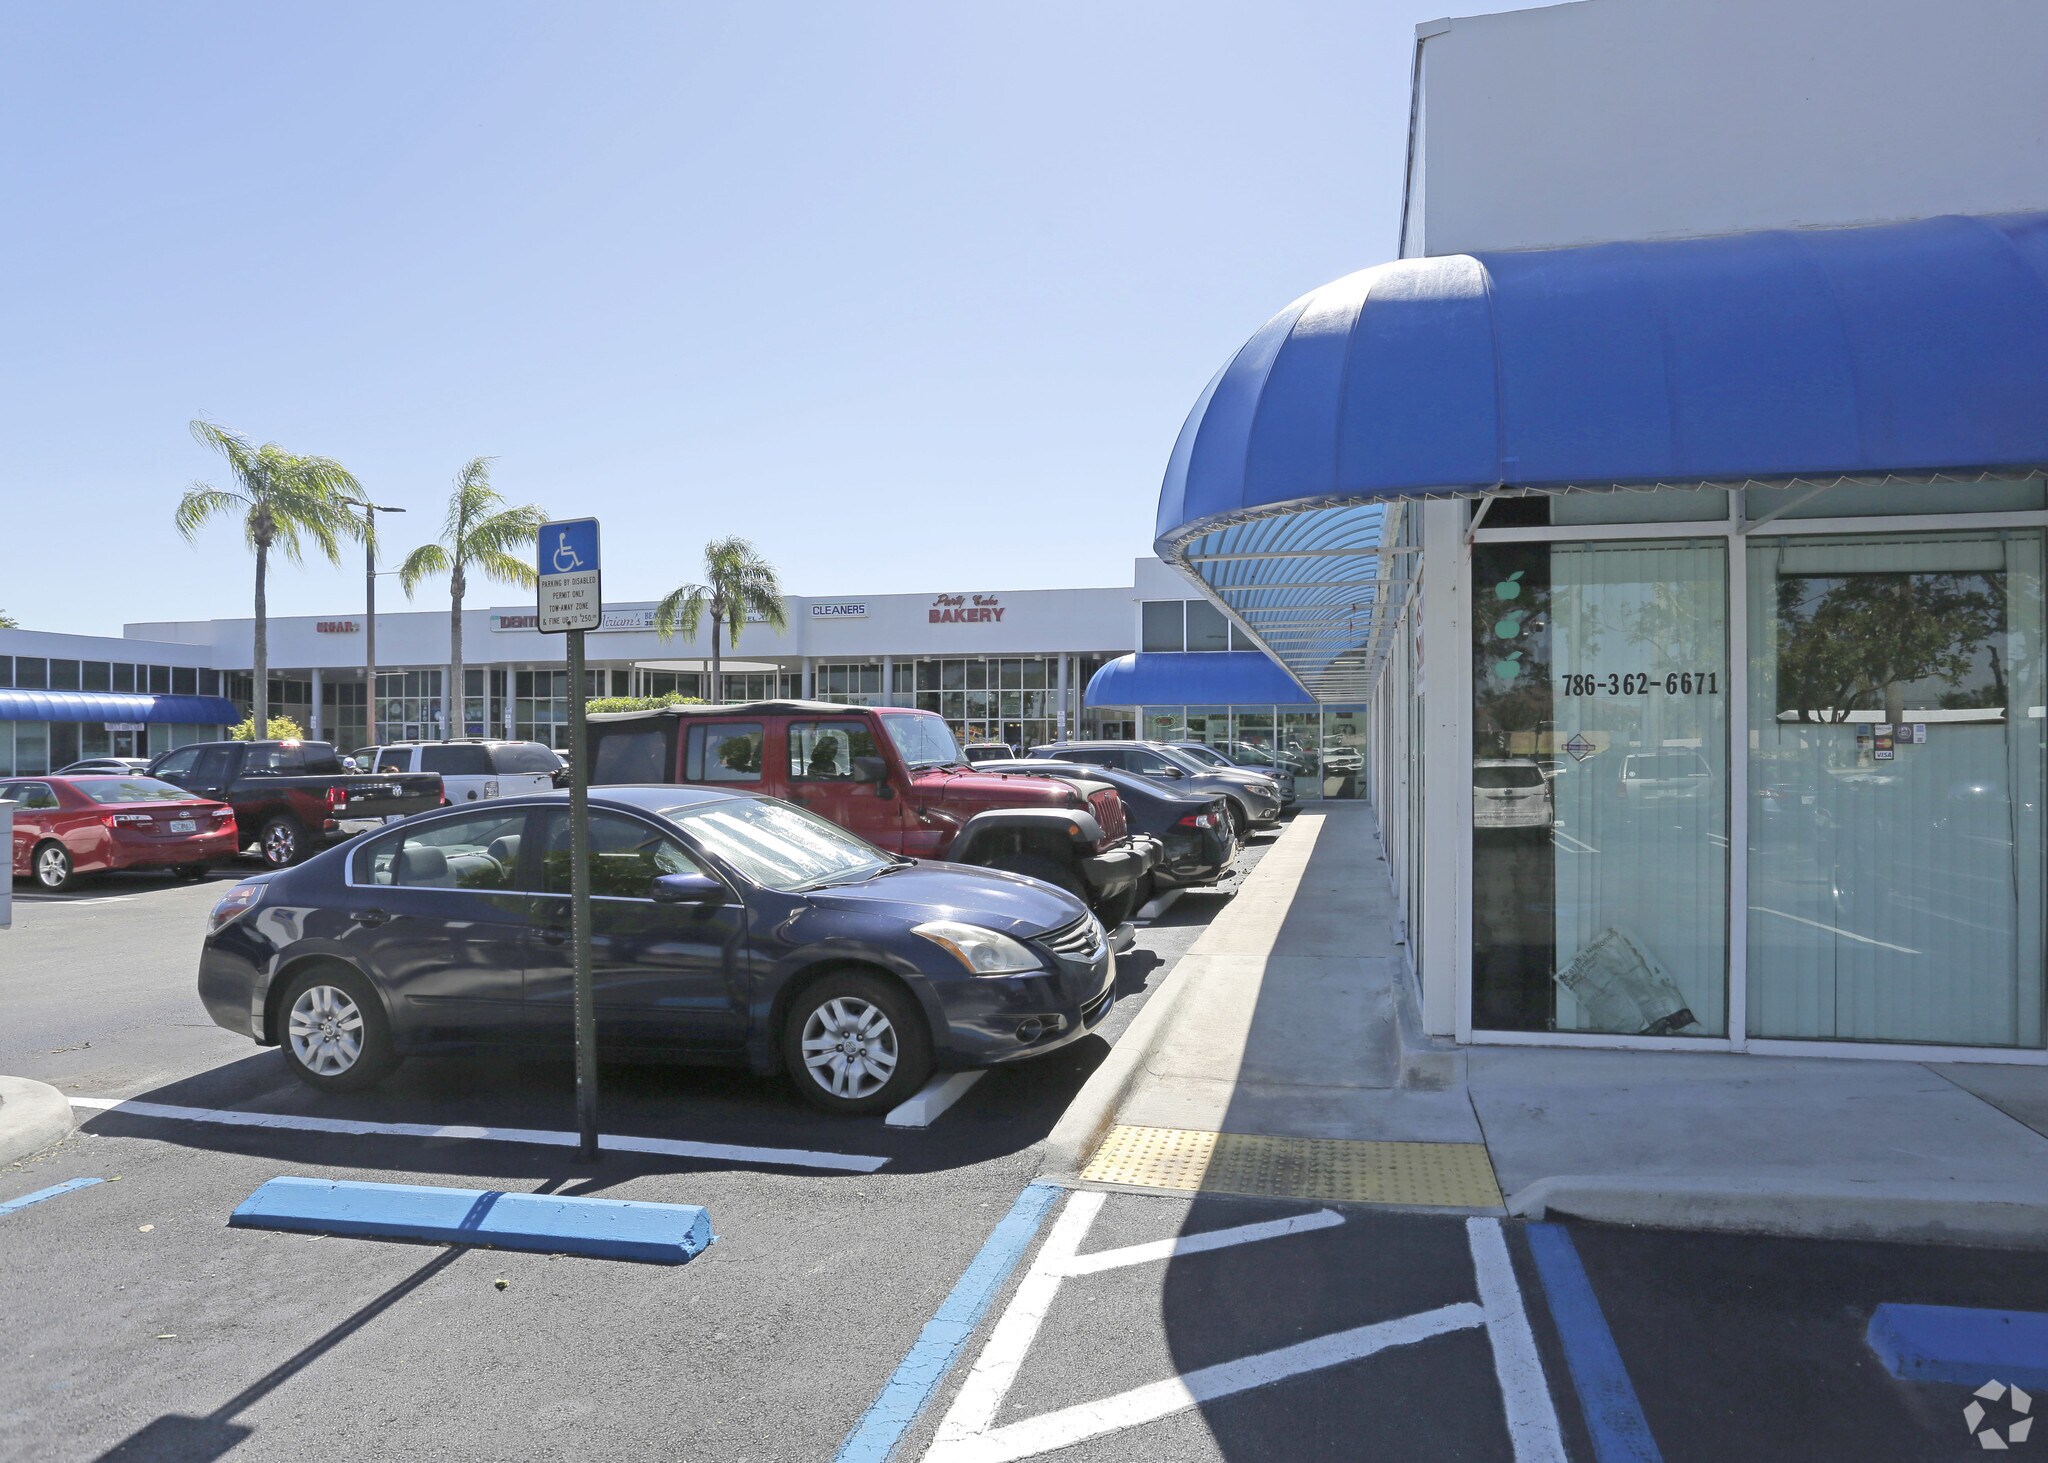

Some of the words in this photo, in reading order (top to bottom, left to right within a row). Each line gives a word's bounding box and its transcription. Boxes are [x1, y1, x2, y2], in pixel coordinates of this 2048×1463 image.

[542, 580, 561, 588] PARKING
[572, 576, 596, 585] DISABLED
[553, 591, 570, 600] PERMIT
[572, 590, 584, 598] ONLY
[932, 593, 966, 608] Party
[549, 604, 573, 613] TOW-AWAY
[576, 602, 589, 610] ZONE
[812, 605, 865, 615] CLEANERS
[549, 617, 560, 625] FINE
[562, 616, 569, 624] UP
[928, 607, 1005, 623] BAKERY
[1562, 672, 1718, 696] 786-362-6671
